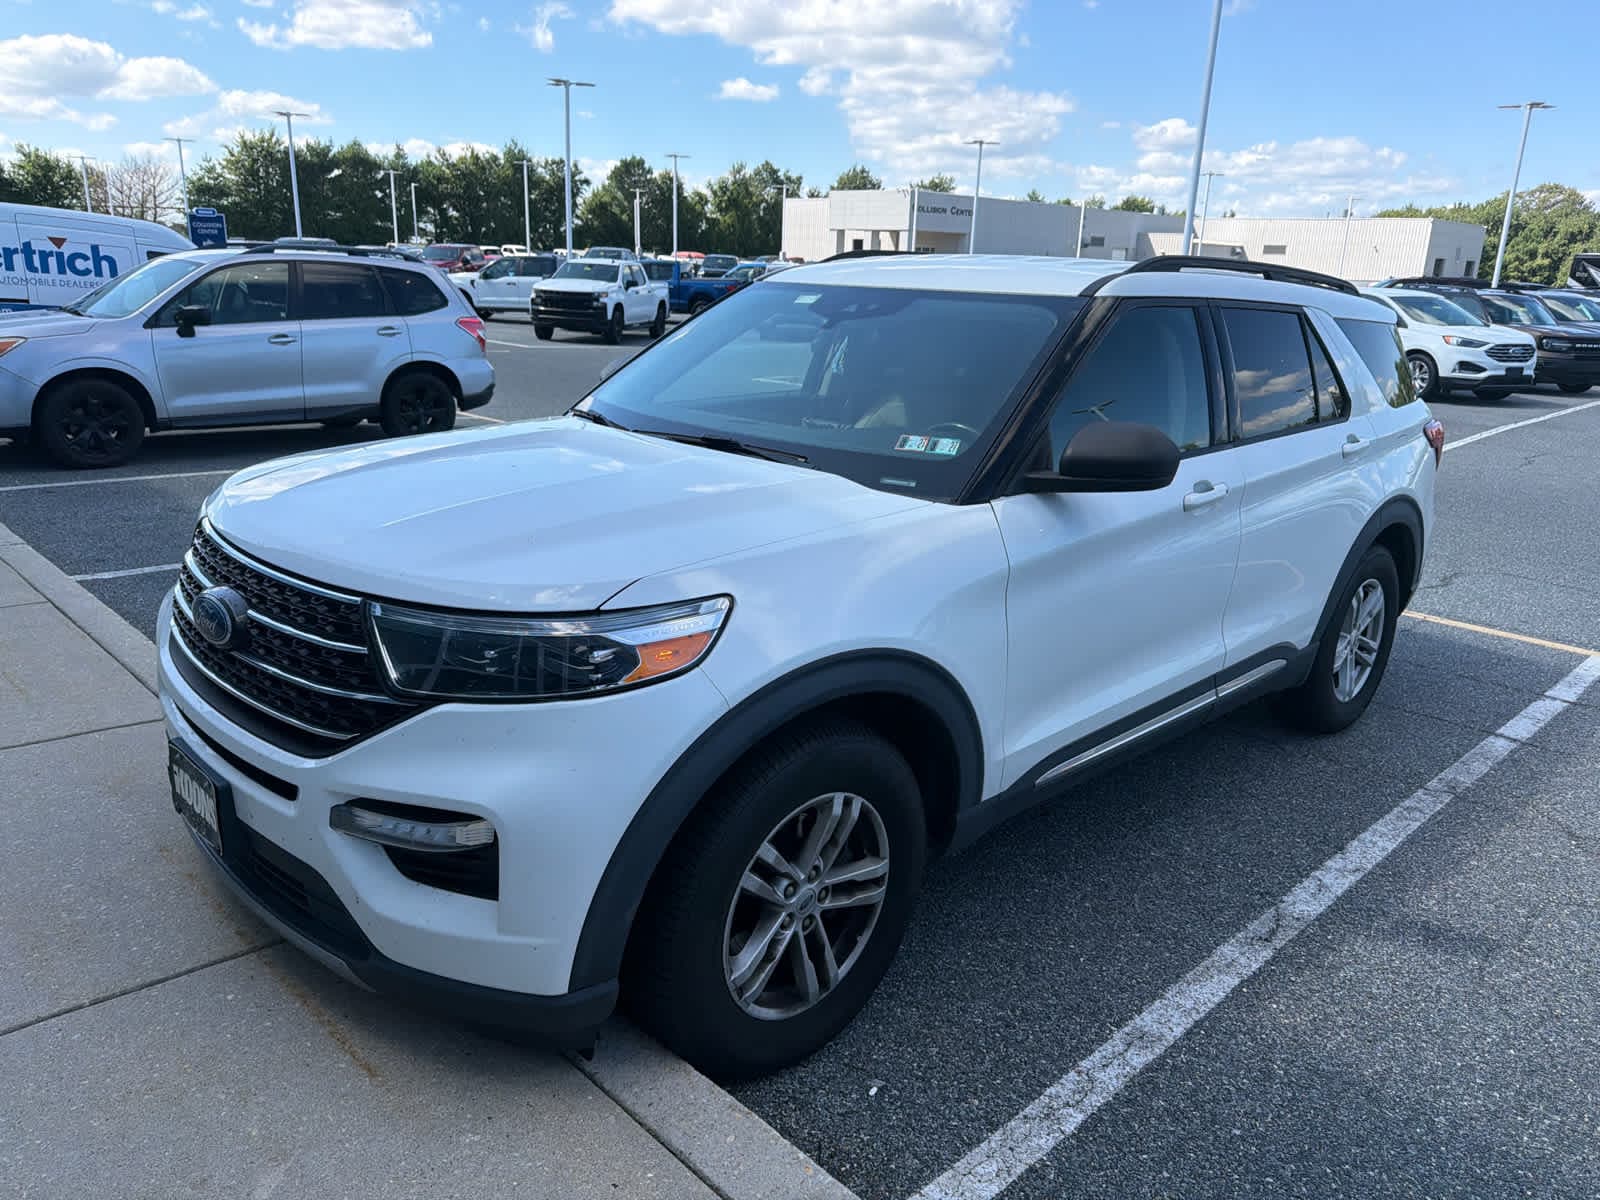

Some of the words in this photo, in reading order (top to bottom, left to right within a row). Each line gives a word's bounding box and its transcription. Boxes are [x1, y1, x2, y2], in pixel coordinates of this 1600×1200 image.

[912, 204, 948, 215] OLLISION
[950, 207, 973, 217] CENTE
[0, 236, 118, 278] rtrich
